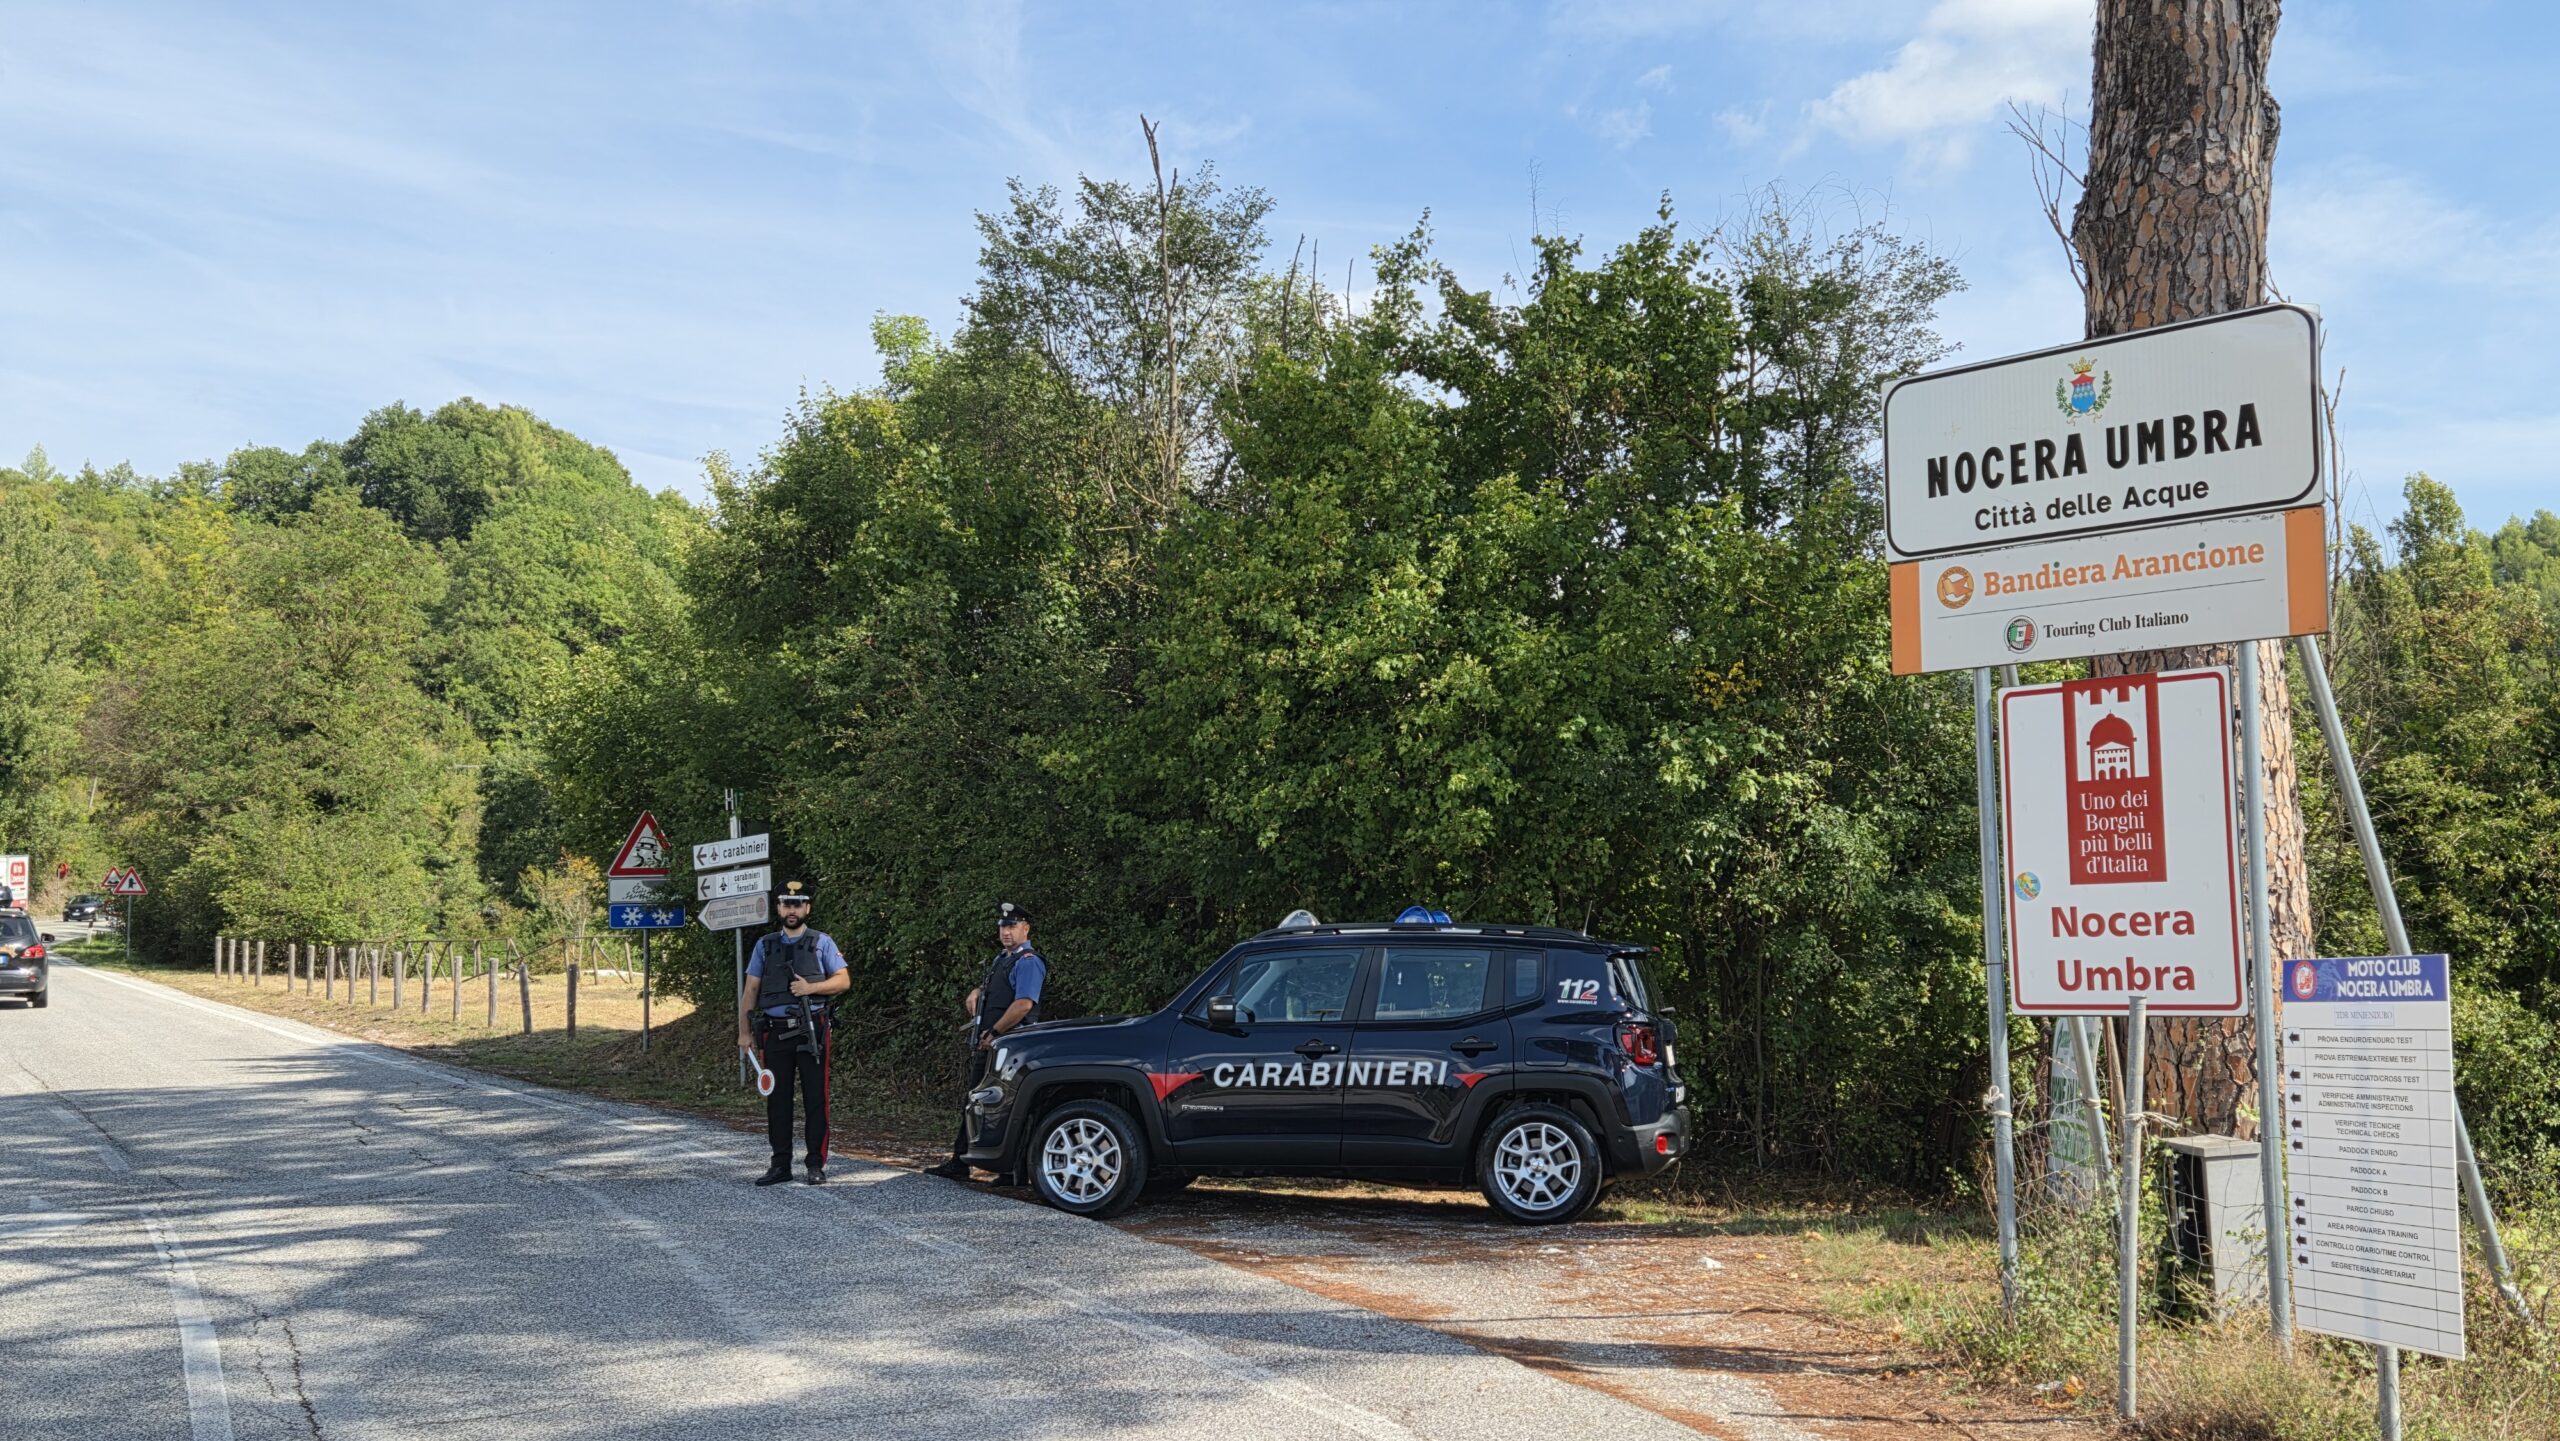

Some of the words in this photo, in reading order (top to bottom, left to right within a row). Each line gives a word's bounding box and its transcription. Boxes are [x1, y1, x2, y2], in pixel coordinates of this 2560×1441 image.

[1928, 433, 2087, 498] NOCERA
[2106, 403, 2263, 469] UMBRA
[1975, 502, 2036, 530] Città
[2046, 493, 2111, 520] delle
[2123, 481, 2209, 509] Acque
[1984, 561, 2106, 597] Bandiera
[2112, 542, 2264, 580] Arancione
[2043, 621, 2095, 639] Touring
[2099, 615, 2131, 633] Club
[2135, 611, 2189, 629] Italiano
[2080, 792, 2115, 810] Uno
[2121, 790, 2148, 807] dei
[2086, 812, 2145, 835] Borghi
[723, 840, 767, 858] carabinieri
[2080, 834, 2107, 856] più
[2114, 832, 2152, 851] belli
[2086, 855, 2148, 874] d'Italia
[734, 870, 760, 882] carabinieri
[737, 881, 759, 893] forestali
[2051, 906, 2195, 938] Nocera
[2057, 957, 2196, 992] Umbra
[2347, 960, 2385, 977] MOTO
[2387, 959, 2421, 976] CLUB
[1558, 978, 1600, 1000] 112
[2337, 979, 2389, 997] NOCERA
[2389, 979, 2434, 997] UMBRA
[2317, 1035, 2339, 1043] PROVA
[2340, 1036, 2395, 1044] ENDURO/ENDURO
[2314, 1053, 2336, 1061] PROVA
[2337, 1054, 2399, 1063] ESTREMA/EXTREME
[2400, 1055, 2416, 1063] TEST
[1213, 1061, 1448, 1087] CARABINIERI
[2313, 1072, 2334, 1080] PROVA
[2336, 1073, 2402, 1083] FETTUCCIATO/CROSS
[2404, 1075, 2420, 1084] TEST
[2318, 1100, 2369, 1110] ADMINISTRATIVE
[2371, 1102, 2414, 1112] INSPECTIONS
[2322, 1092, 2355, 1100] VERIFICHE
[2356, 1093, 2409, 1103] AMMINISTRATIVE
[2335, 1119, 2368, 1128] VERIFICHE
[2369, 1121, 2401, 1130] TECNICHE
[2337, 1128, 2372, 1137] TECHNICAL
[2373, 1130, 2400, 1139] CHECKS
[2339, 1145, 2369, 1155] PADDOCK
[2370, 1147, 2398, 1157] ENDURO
[2350, 1166, 2381, 1176] PADDOCK
[2351, 1186, 2382, 1196] PADDOCK
[2347, 1205, 2368, 1214] PARCO
[2369, 1207, 2394, 1217] CHIUSO
[2327, 1222, 2344, 1231] AREA
[2346, 1224, 2386, 1236] PROVA/AREA
[2387, 1229, 2419, 1240] TRAINING
[2316, 1240, 2354, 1251] CONTROLLO
[2355, 1245, 2397, 1258] ORARIO/TIME
[2398, 1250, 2430, 1262] CONTROL
[2331, 1261, 2416, 1281] SEGRETERIA/SECRETARIAT
